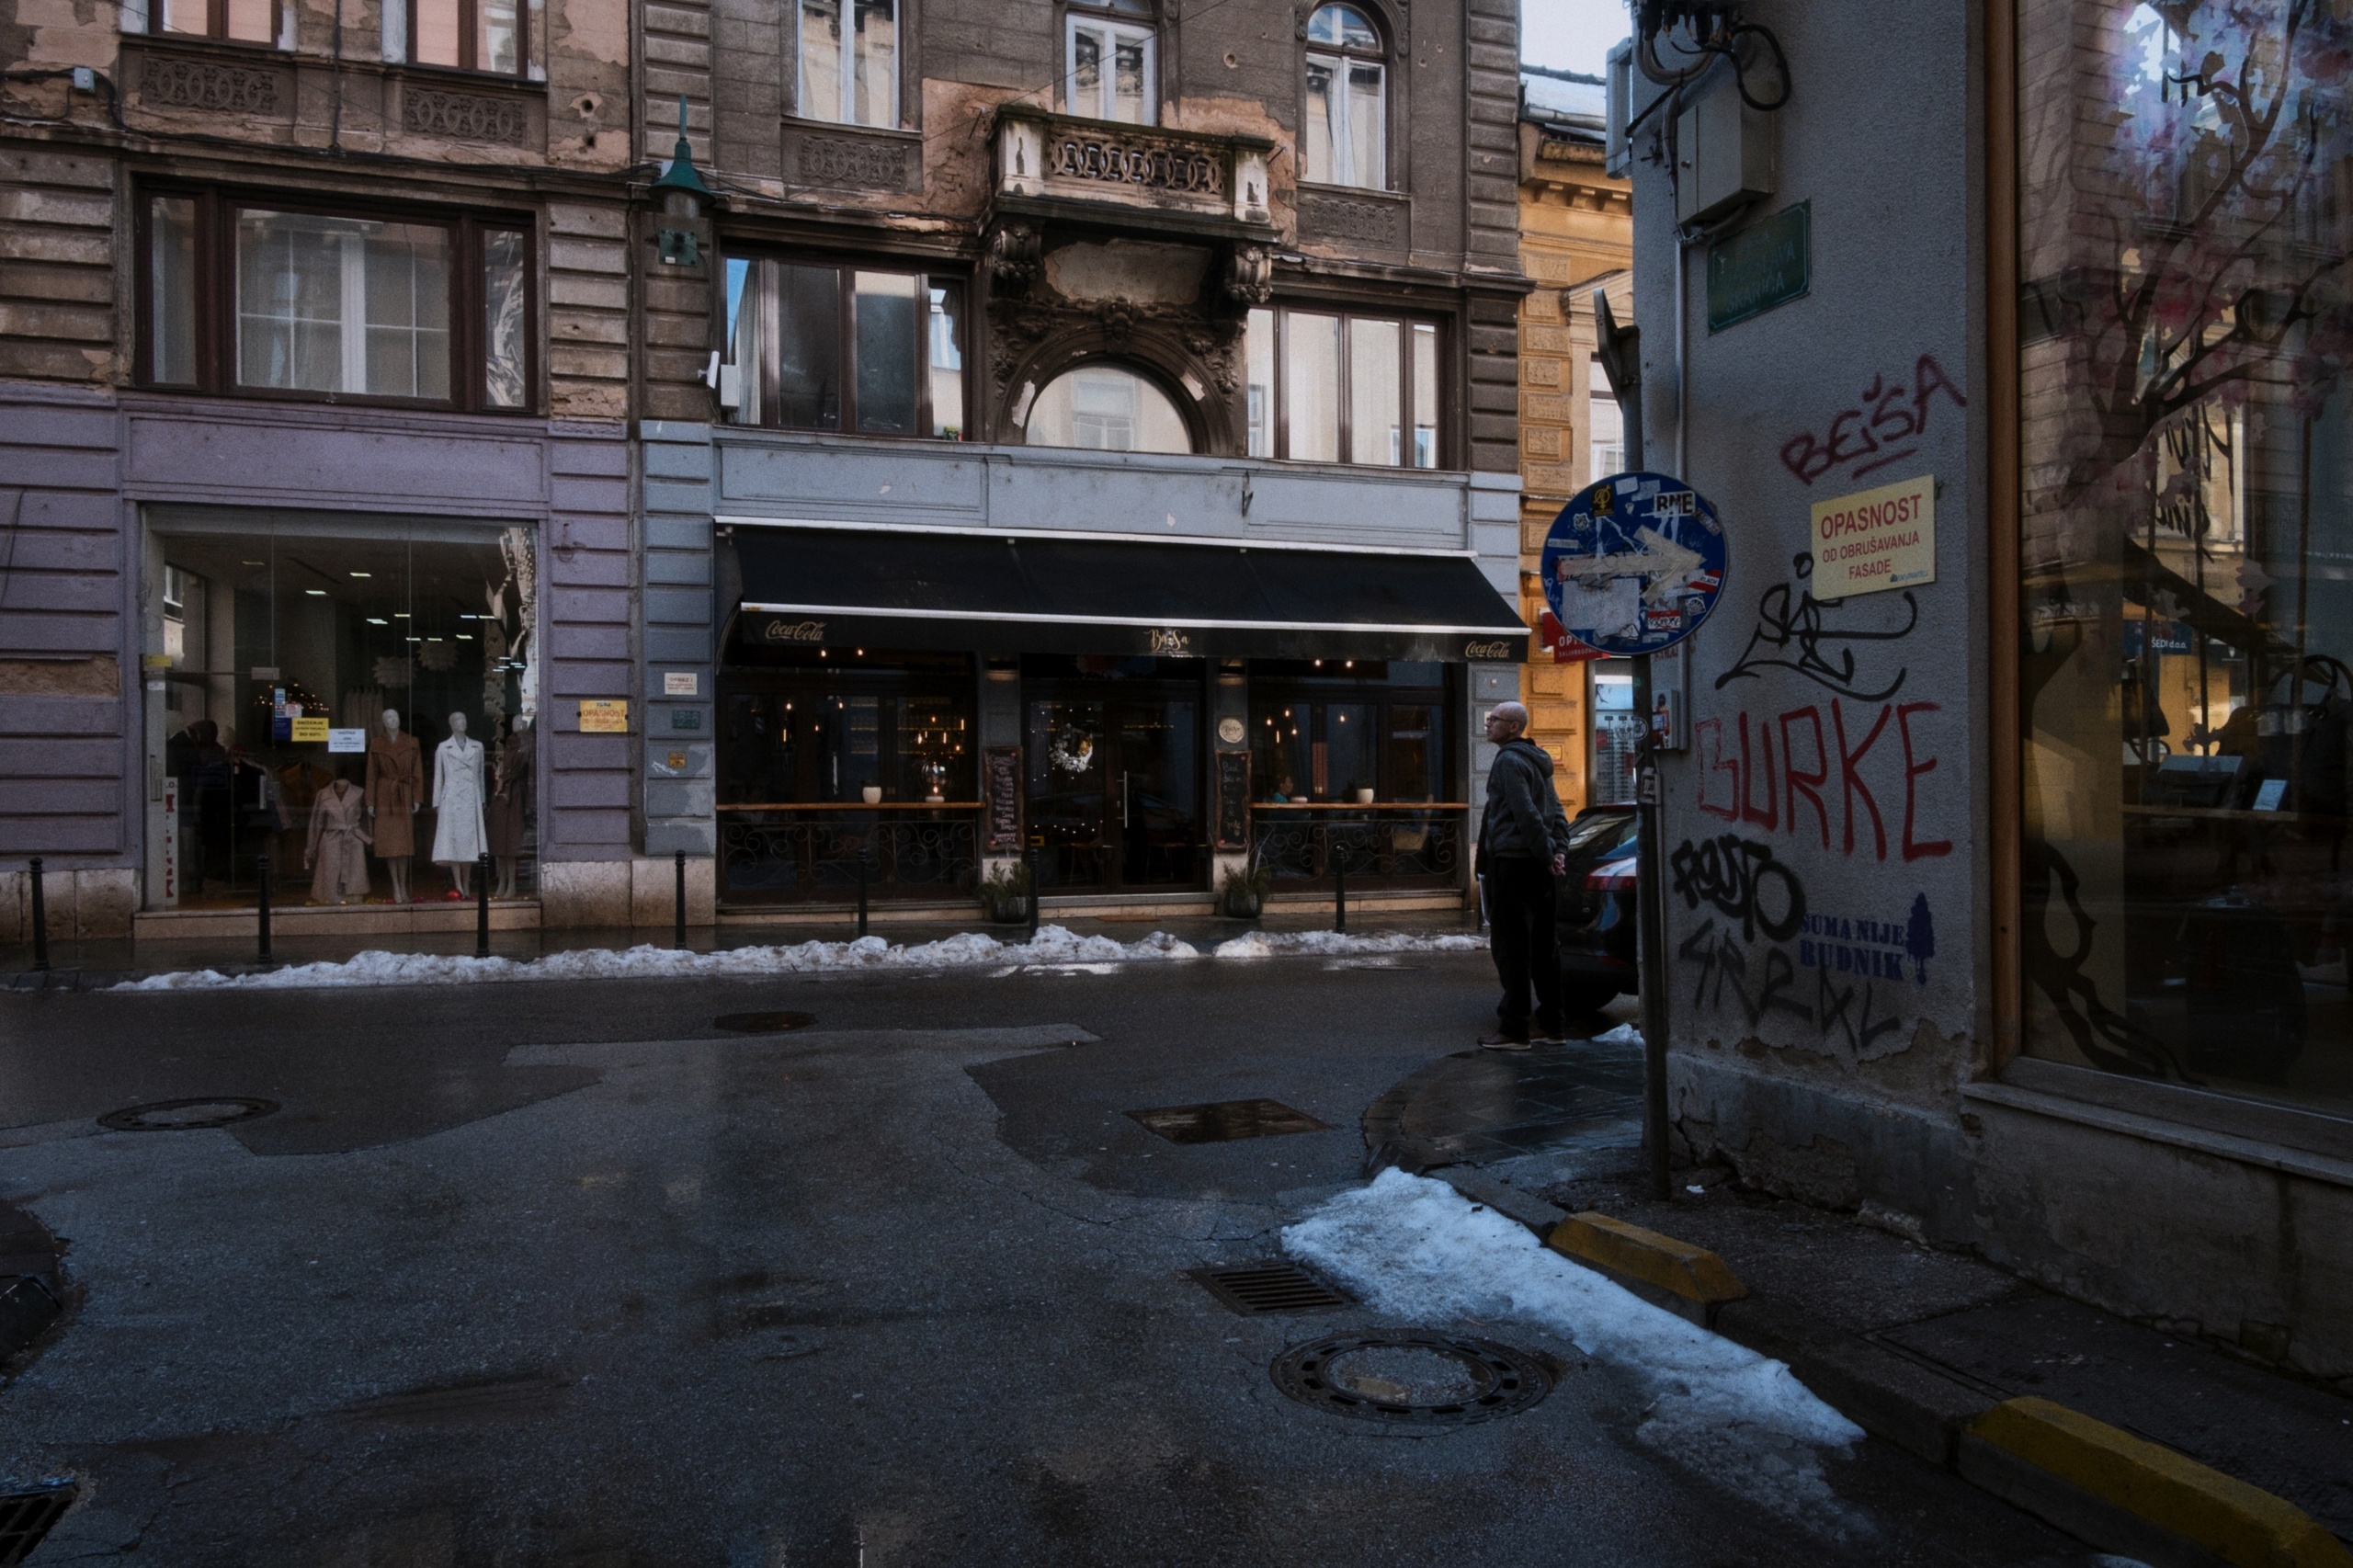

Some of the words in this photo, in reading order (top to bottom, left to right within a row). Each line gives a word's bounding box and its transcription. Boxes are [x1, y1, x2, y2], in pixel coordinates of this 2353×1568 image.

[1821, 494, 1922, 540] OPASNOST
[1823, 548, 1837, 562] OD
[1839, 530, 1920, 560] OBRUŠAVANJA
[1848, 559, 1892, 580] FASADE
[1856, 920, 1904, 947] NIJE
[1800, 939, 1904, 981] RUDNIK
